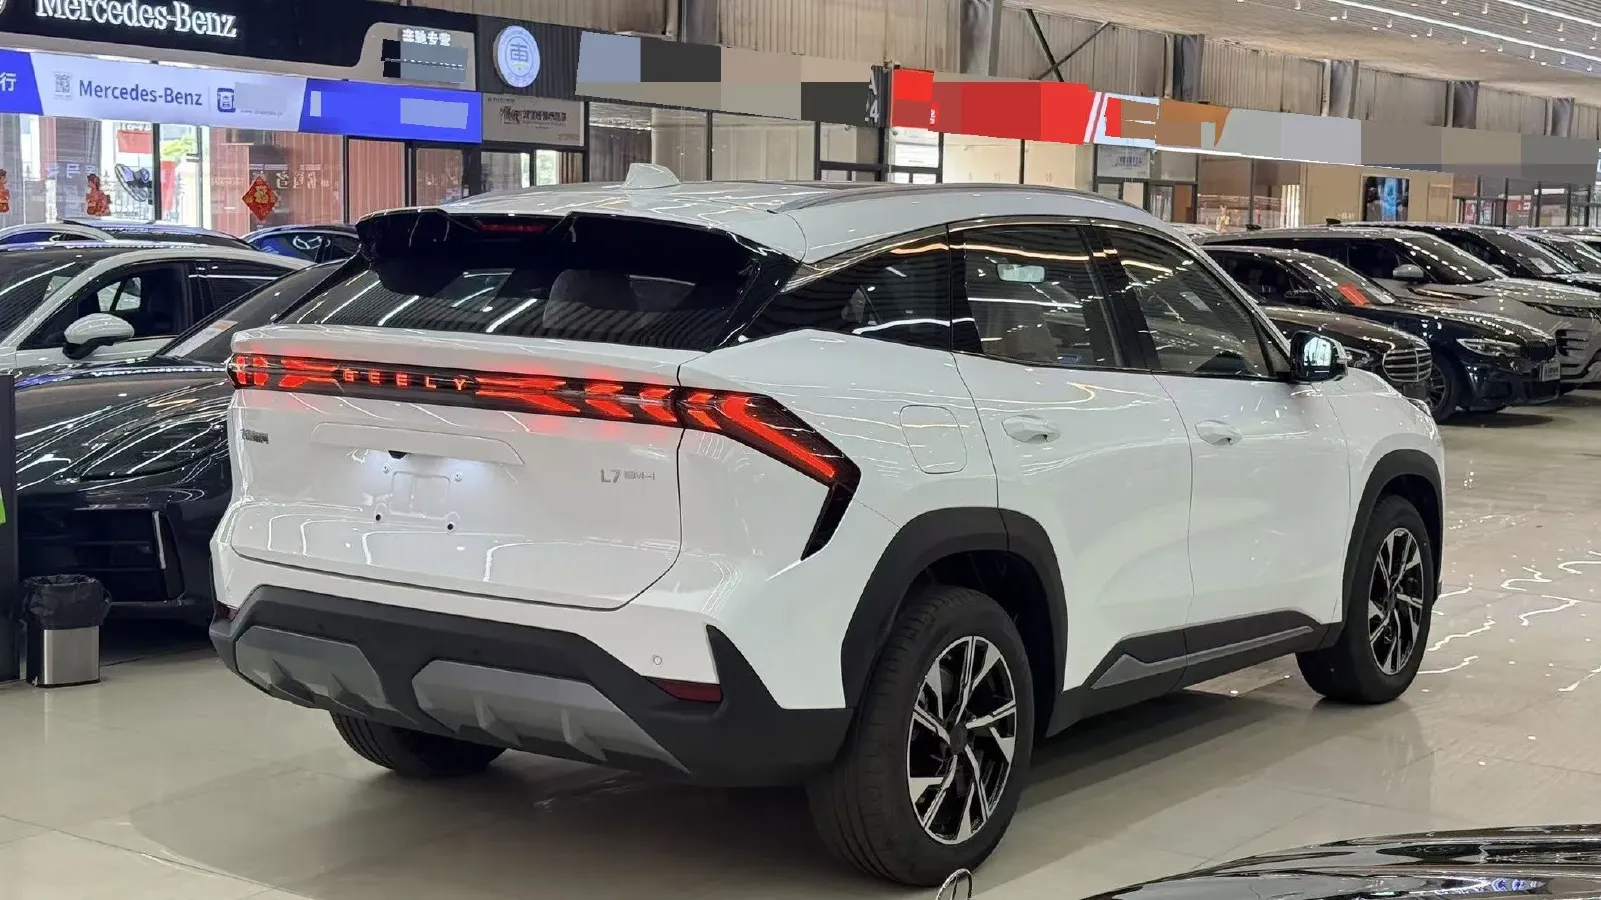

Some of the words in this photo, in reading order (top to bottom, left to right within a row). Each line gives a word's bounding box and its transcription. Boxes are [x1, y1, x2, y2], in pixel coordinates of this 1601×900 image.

[35, 0, 237, 38] Mercedes-Benz
[79, 79, 203, 106] Mercedes-Benz
[343, 369, 466, 391] GEELY
[600, 469, 621, 483] L7
